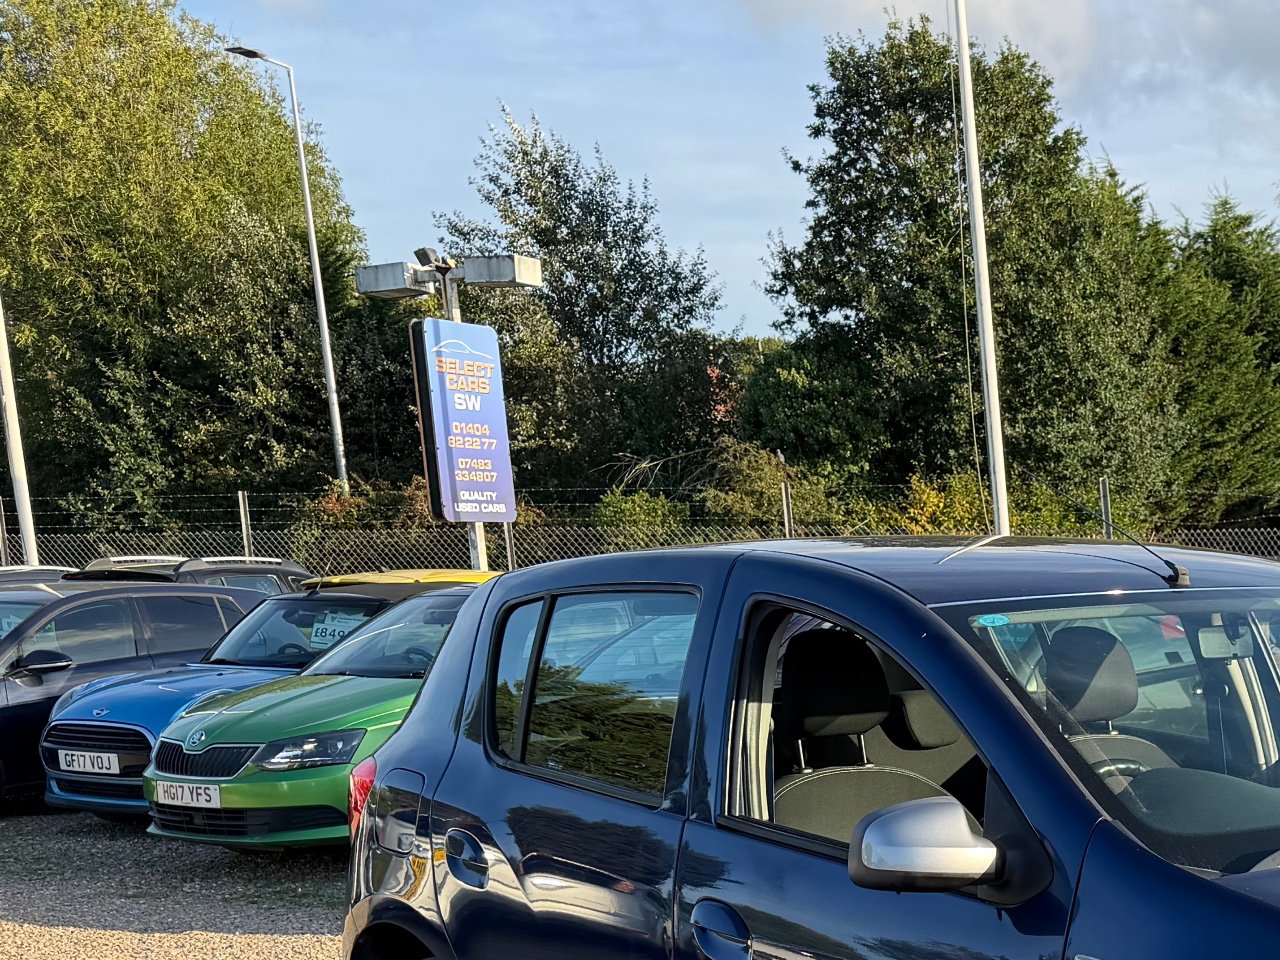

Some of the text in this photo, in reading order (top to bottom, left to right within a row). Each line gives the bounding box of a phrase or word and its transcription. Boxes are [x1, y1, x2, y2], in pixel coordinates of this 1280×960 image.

[436, 357, 494, 378] SELECT
[446, 374, 490, 394] CARS
[453, 392, 482, 412] SW
[452, 421, 490, 436] 01404
[454, 470, 498, 482] 334807
[459, 490, 498, 501] QUALITY
[454, 502, 507, 513] USED CARS
[65, 753, 112, 771] GF17 VOJ
[163, 783, 212, 803] HG17 YFS
